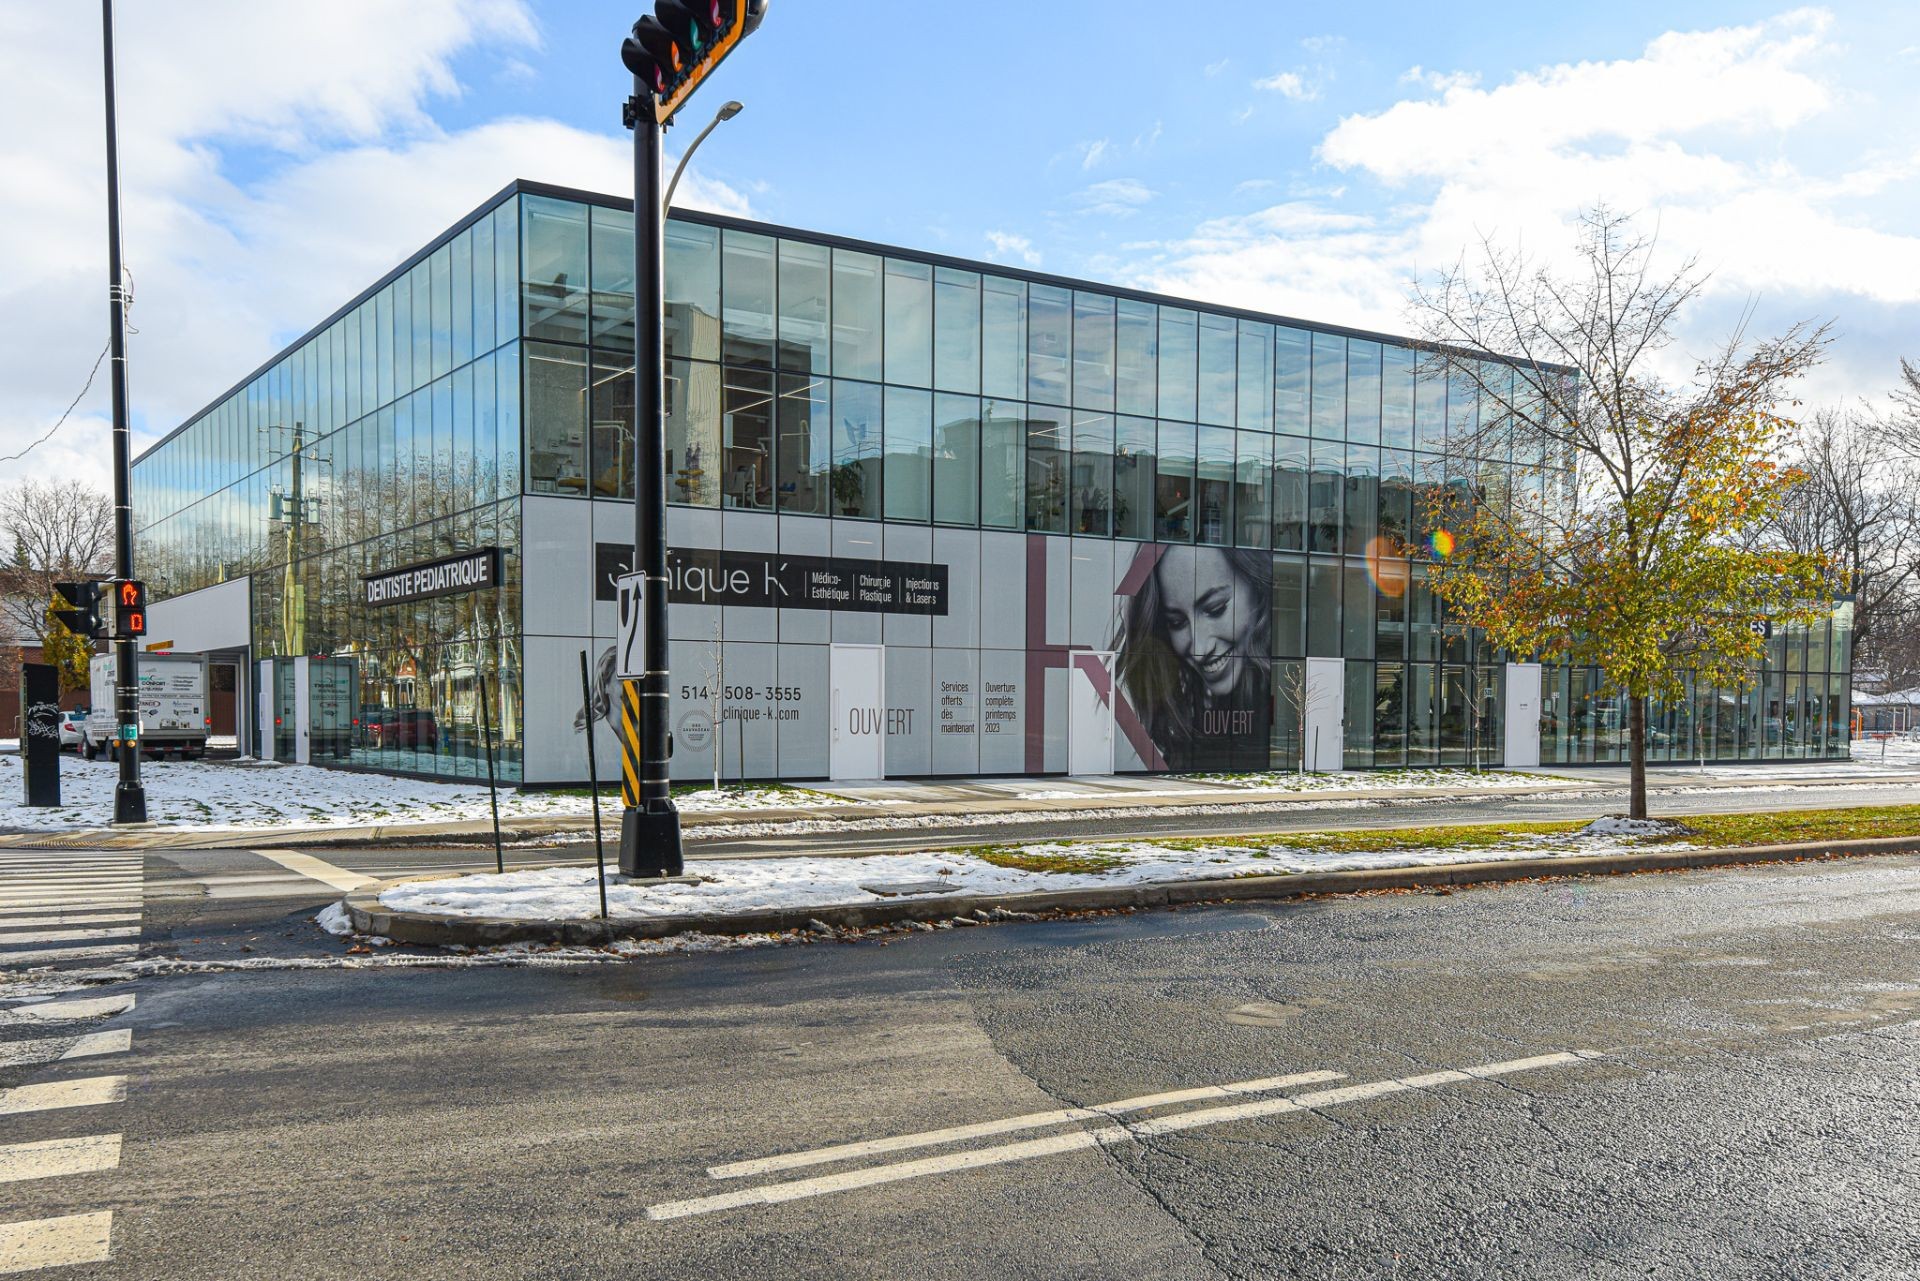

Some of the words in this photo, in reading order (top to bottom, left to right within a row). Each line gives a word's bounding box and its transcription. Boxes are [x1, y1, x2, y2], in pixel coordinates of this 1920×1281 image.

[367, 573, 413, 602] DENTISTE
[413, 556, 488, 593] PEDIATRIQUE
[765, 561, 790, 597] K
[811, 571, 842, 585] Médico-
[905, 577, 940, 592] Injections
[811, 586, 850, 602] Esthétique
[859, 588, 892, 604] Plastique
[905, 591, 912, 603] &
[912, 592, 937, 605] Lasers
[941, 681, 969, 692] Services
[985, 682, 1016, 693] Ouverture
[941, 695, 963, 706] offerts
[985, 695, 1014, 708] complète
[849, 707, 915, 735] OUVERT
[941, 708, 953, 720] dès
[985, 708, 1017, 721] printemps
[941, 722, 975, 733] maintenant
[985, 722, 1000, 733] 2023
[1203, 710, 1255, 735] OUVERT
